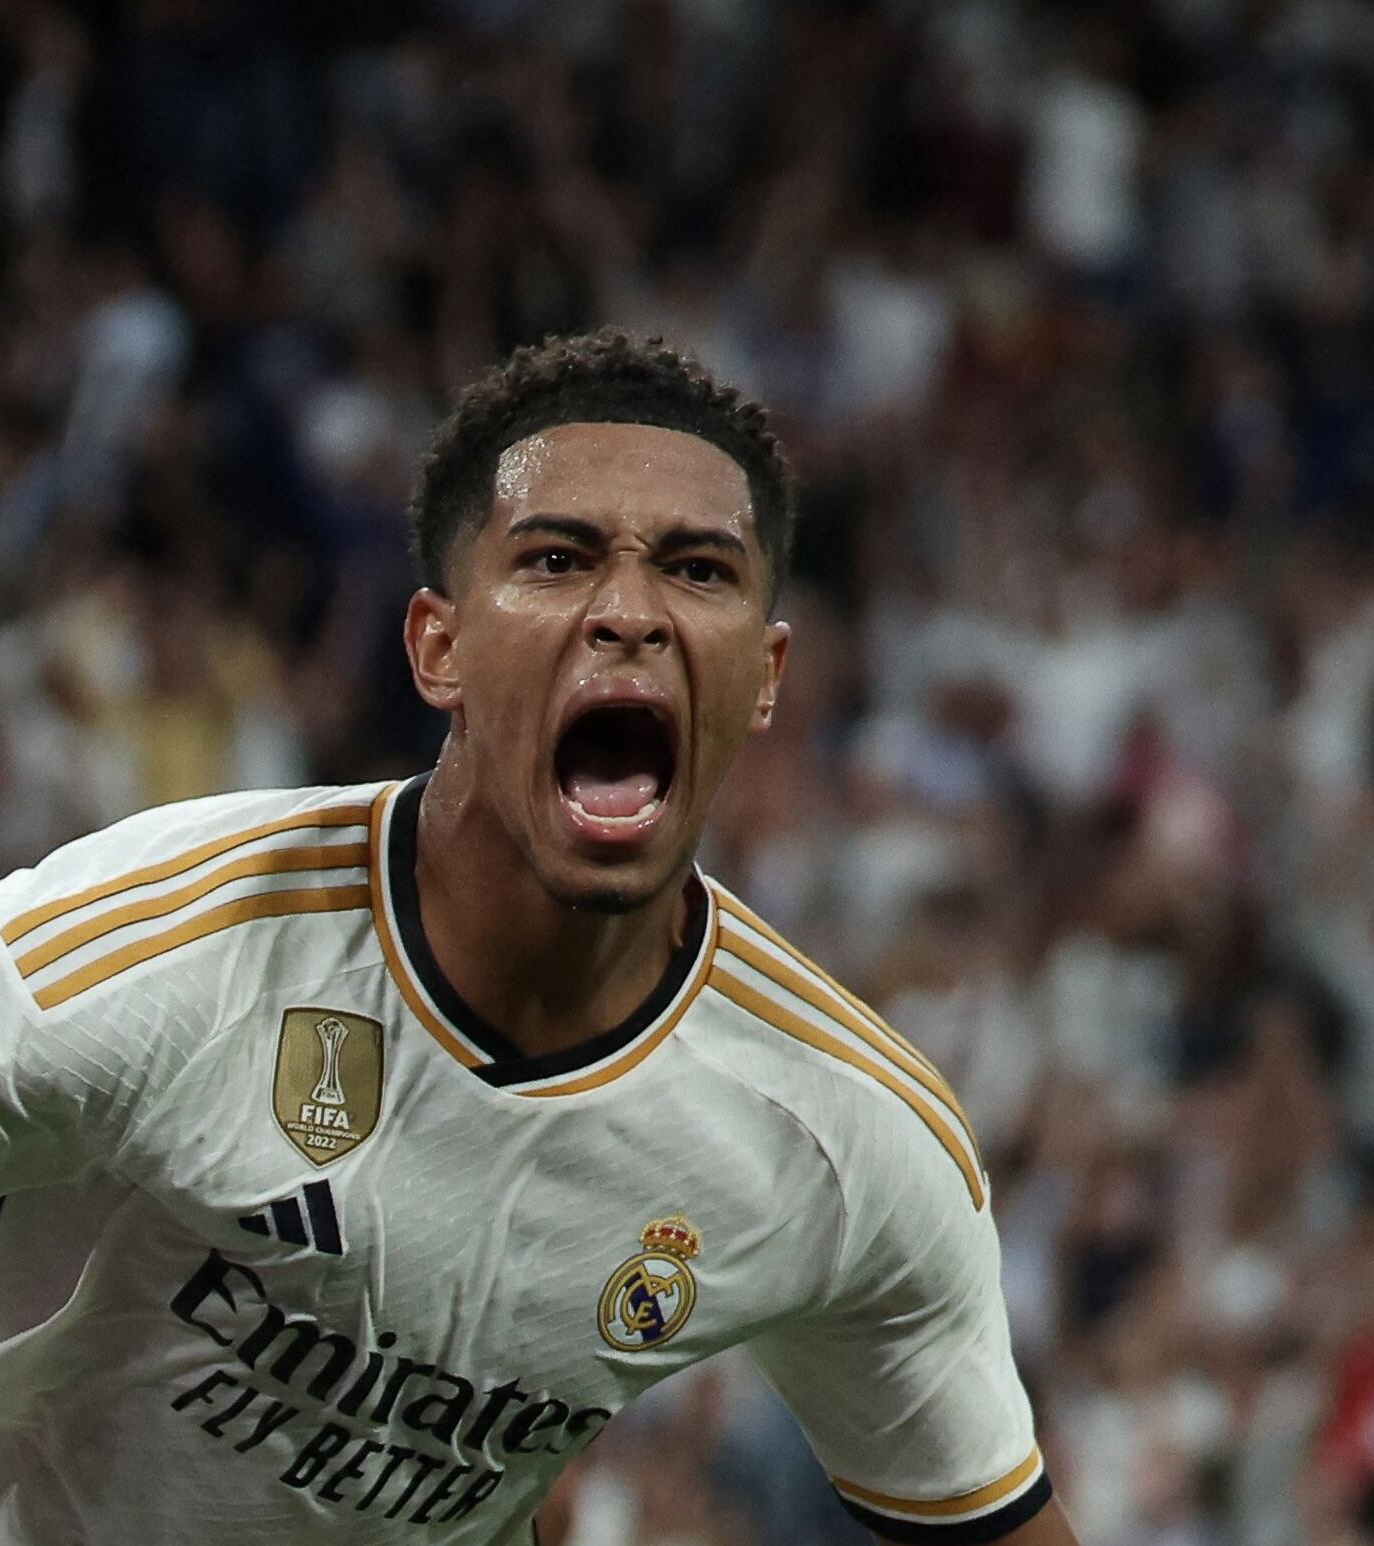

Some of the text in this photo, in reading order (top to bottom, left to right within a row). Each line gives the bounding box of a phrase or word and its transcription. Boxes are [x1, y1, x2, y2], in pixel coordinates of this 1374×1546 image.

[301, 1104, 350, 1130] FIFA
[306, 1134, 337, 1149] 2022
[170, 1370, 505, 1524] FLY BETTER
